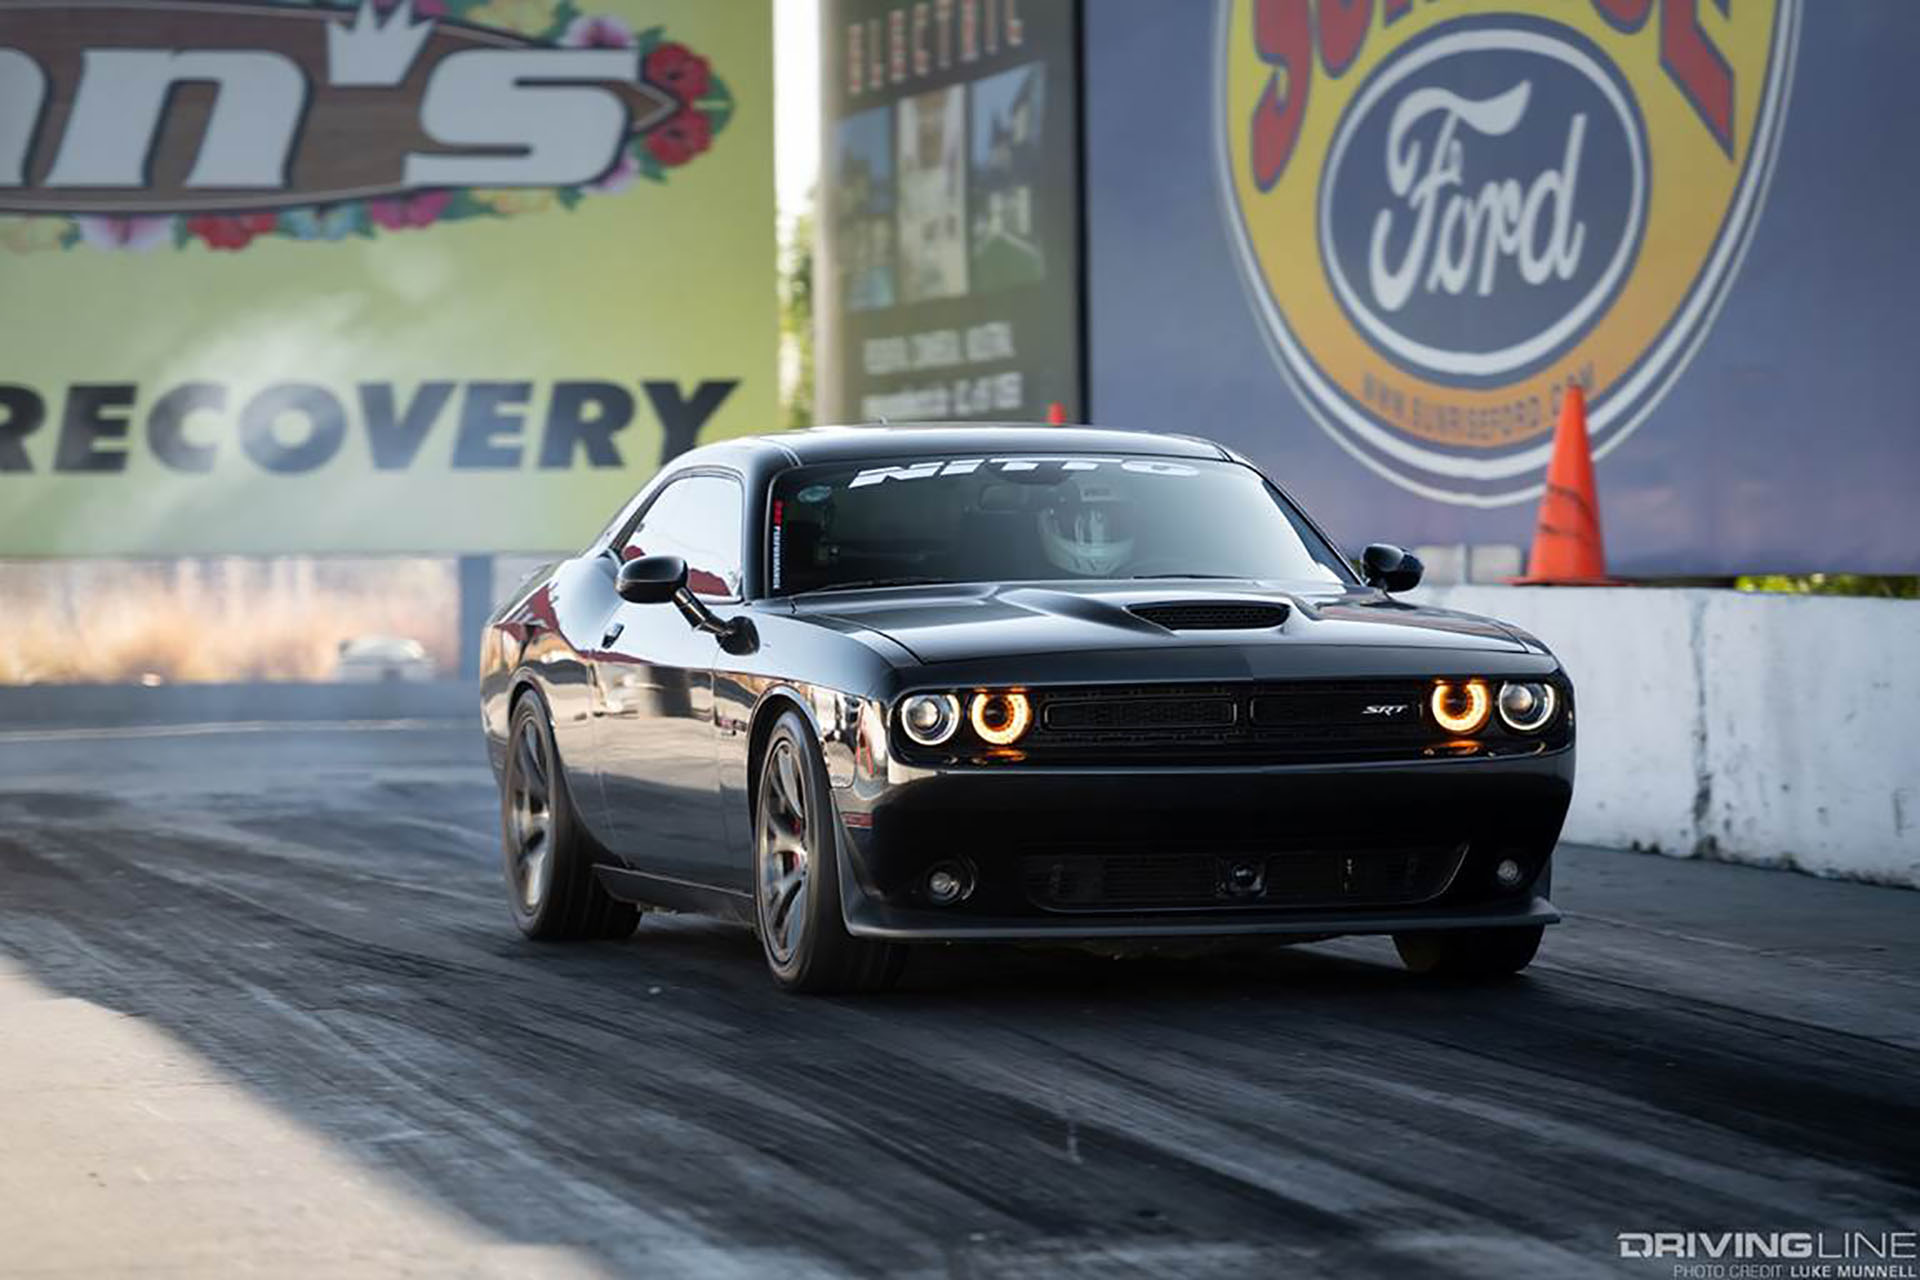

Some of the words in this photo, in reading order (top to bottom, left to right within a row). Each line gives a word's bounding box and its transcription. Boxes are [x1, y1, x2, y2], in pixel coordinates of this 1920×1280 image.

[1369, 79, 1588, 312] Ford
[849, 458, 1199, 488] NITTO
[1362, 704, 1408, 716] SRT
